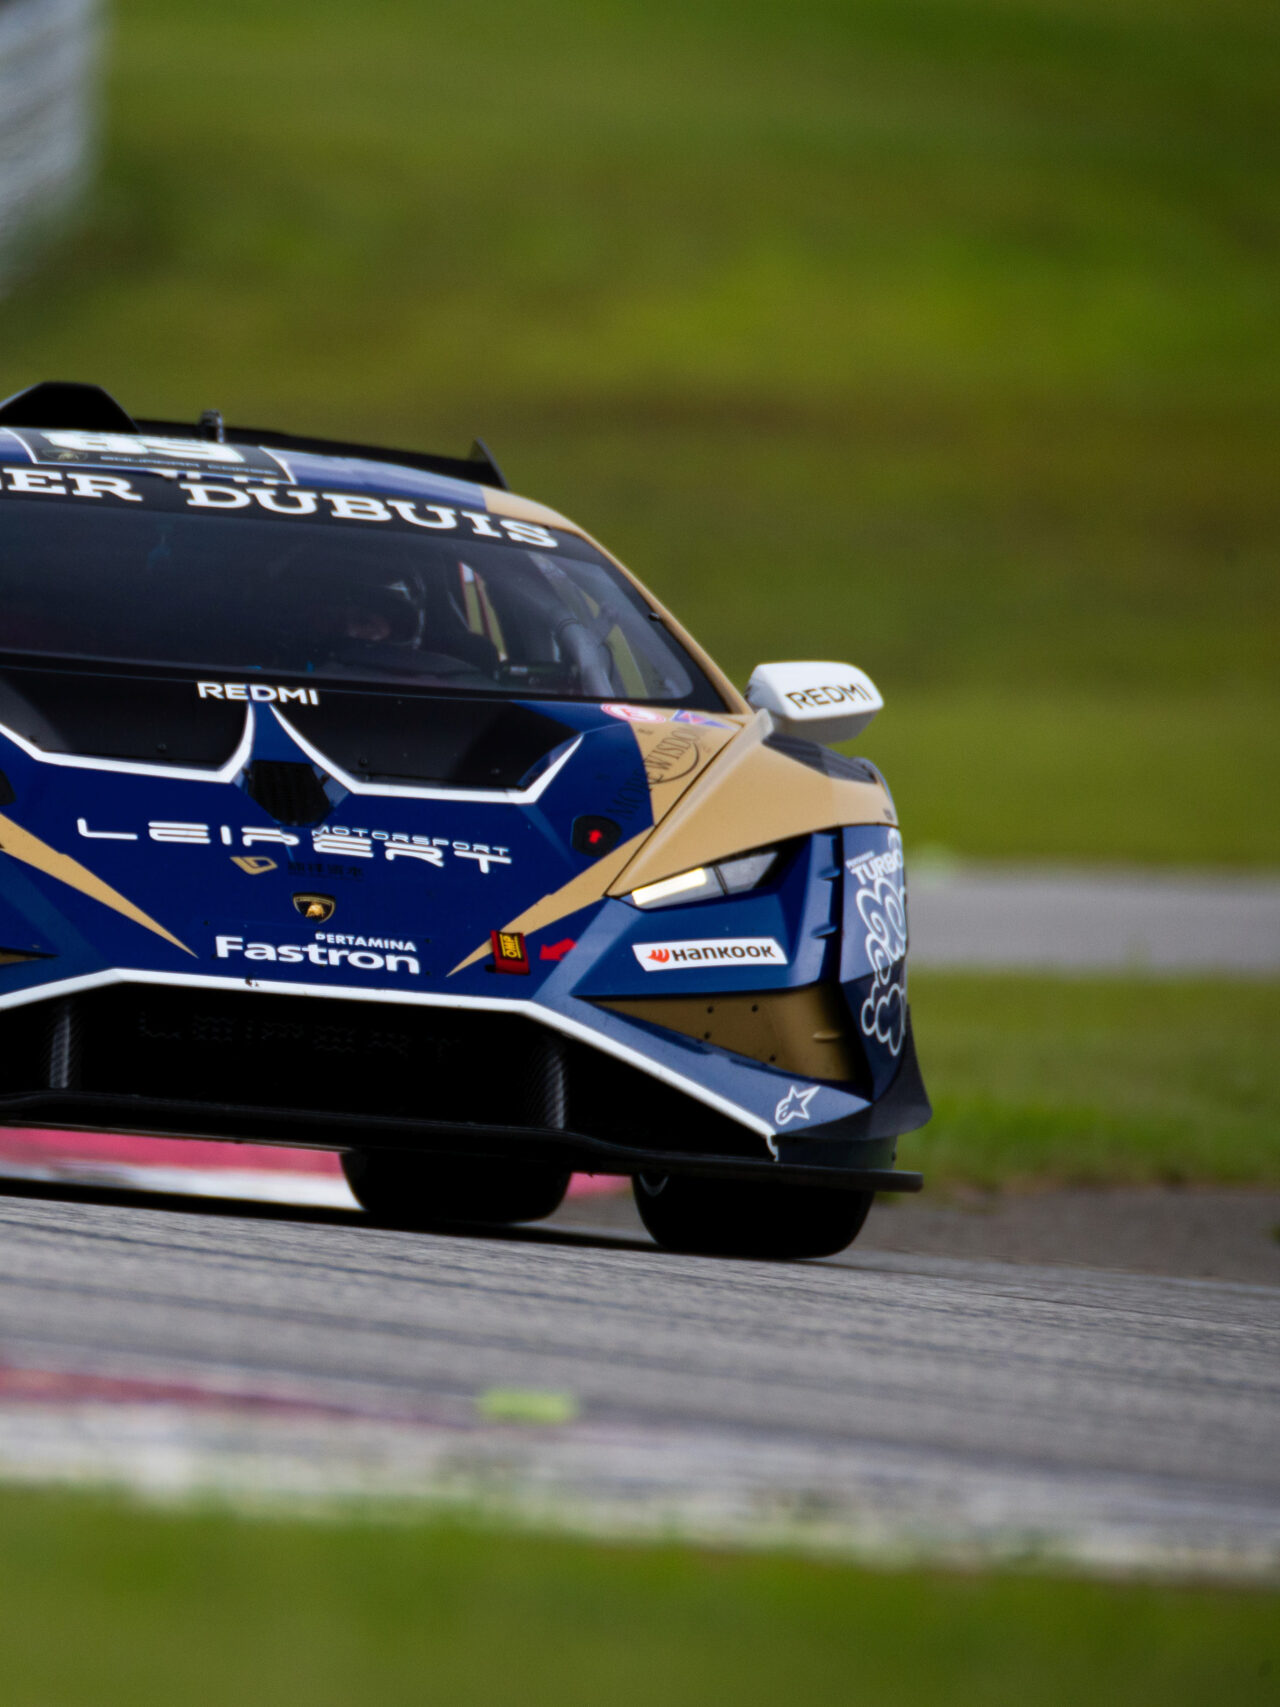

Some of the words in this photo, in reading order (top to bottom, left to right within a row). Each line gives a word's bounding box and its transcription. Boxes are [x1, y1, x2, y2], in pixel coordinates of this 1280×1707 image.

[179, 482, 559, 549] DUBUIS
[198, 681, 320, 706] REDMI
[785, 684, 873, 711] REDMI
[76, 817, 513, 875] LEIPERT
[311, 825, 511, 856] MOTORSPORT
[215, 936, 422, 976] Fastron
[315, 931, 418, 952] PERTAMINA
